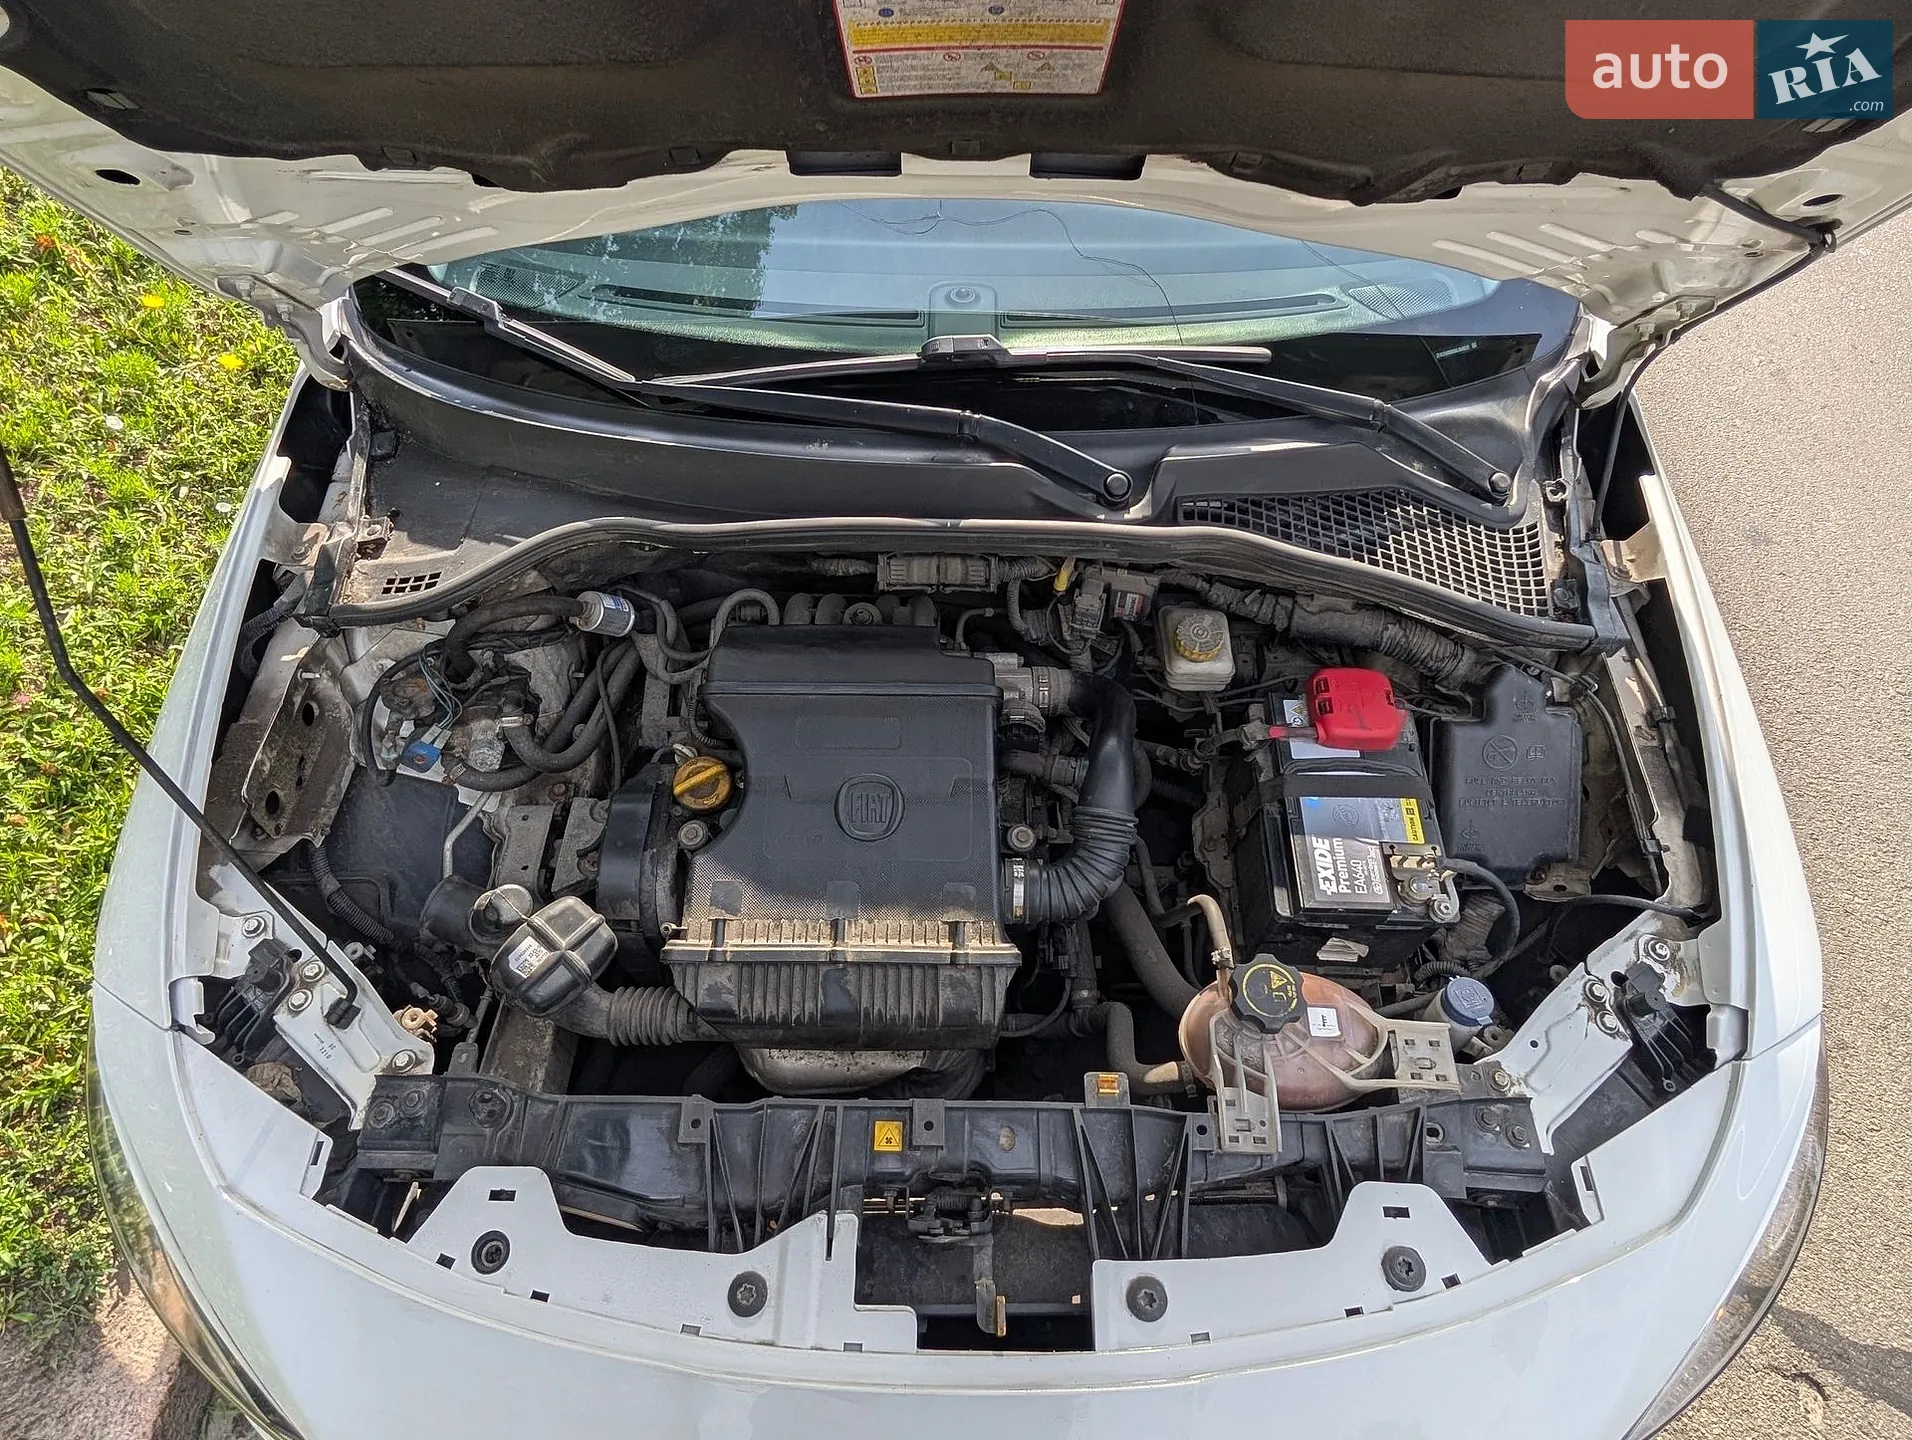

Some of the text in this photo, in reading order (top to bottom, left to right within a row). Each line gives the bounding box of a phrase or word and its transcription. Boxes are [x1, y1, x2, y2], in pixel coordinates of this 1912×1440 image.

[850, 792, 891, 823] FIAT
[1409, 817, 1419, 841] CAUTION
[1312, 836, 1338, 895] EXIDE
[1332, 838, 1352, 893] Premium
[1350, 860, 1367, 894] EA640
